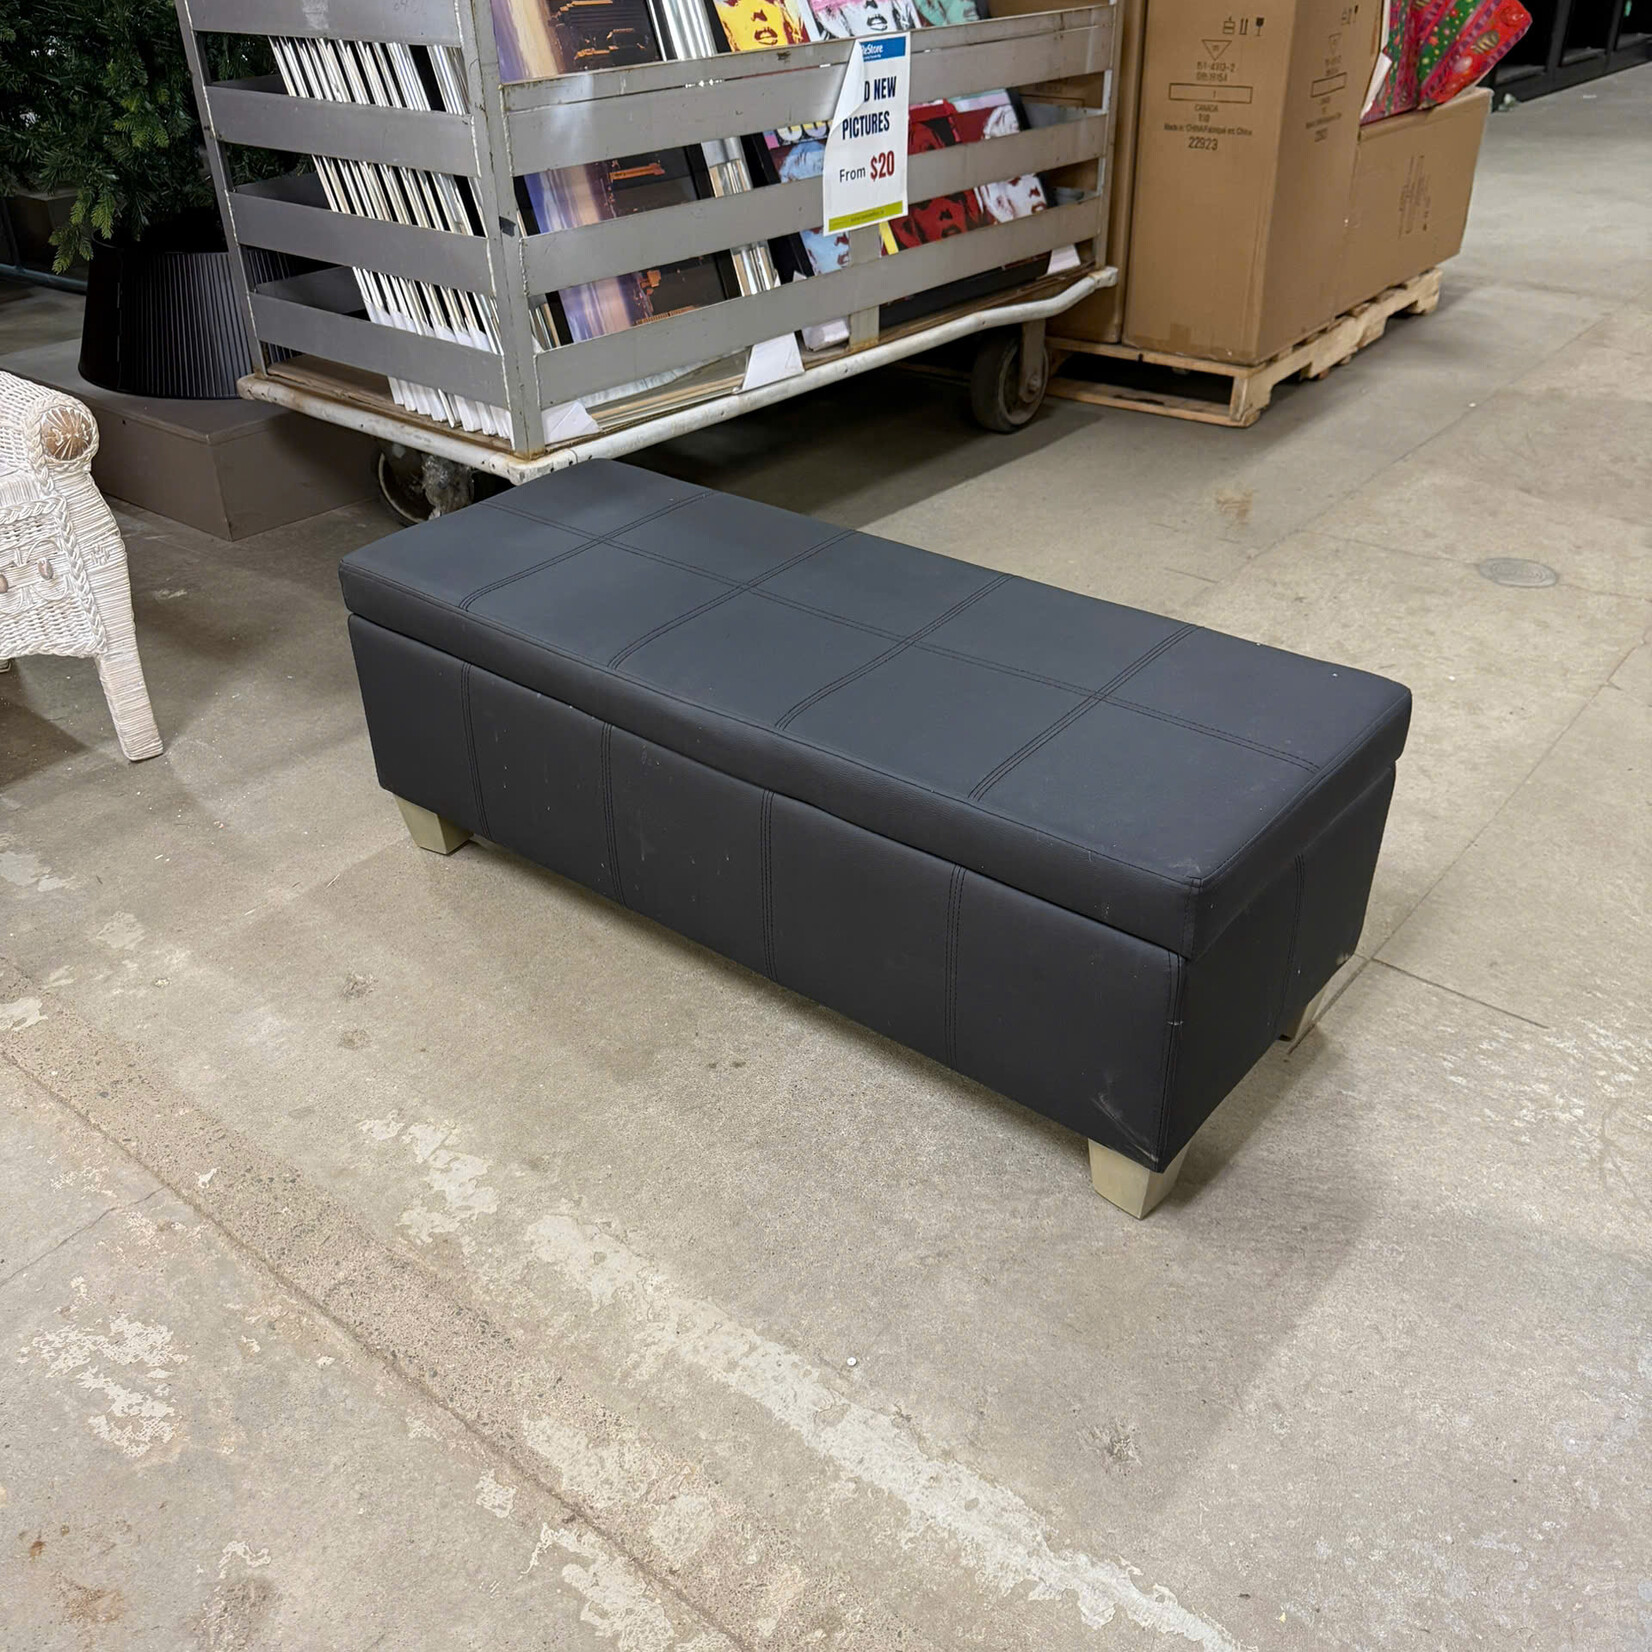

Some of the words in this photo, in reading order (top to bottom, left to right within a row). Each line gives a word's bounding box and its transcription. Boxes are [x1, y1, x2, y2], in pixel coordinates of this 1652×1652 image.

[873, 75, 897, 101] NEW
[842, 110, 890, 141] PICTURES
[839, 166, 866, 183] From
[870, 150, 895, 182] $20
